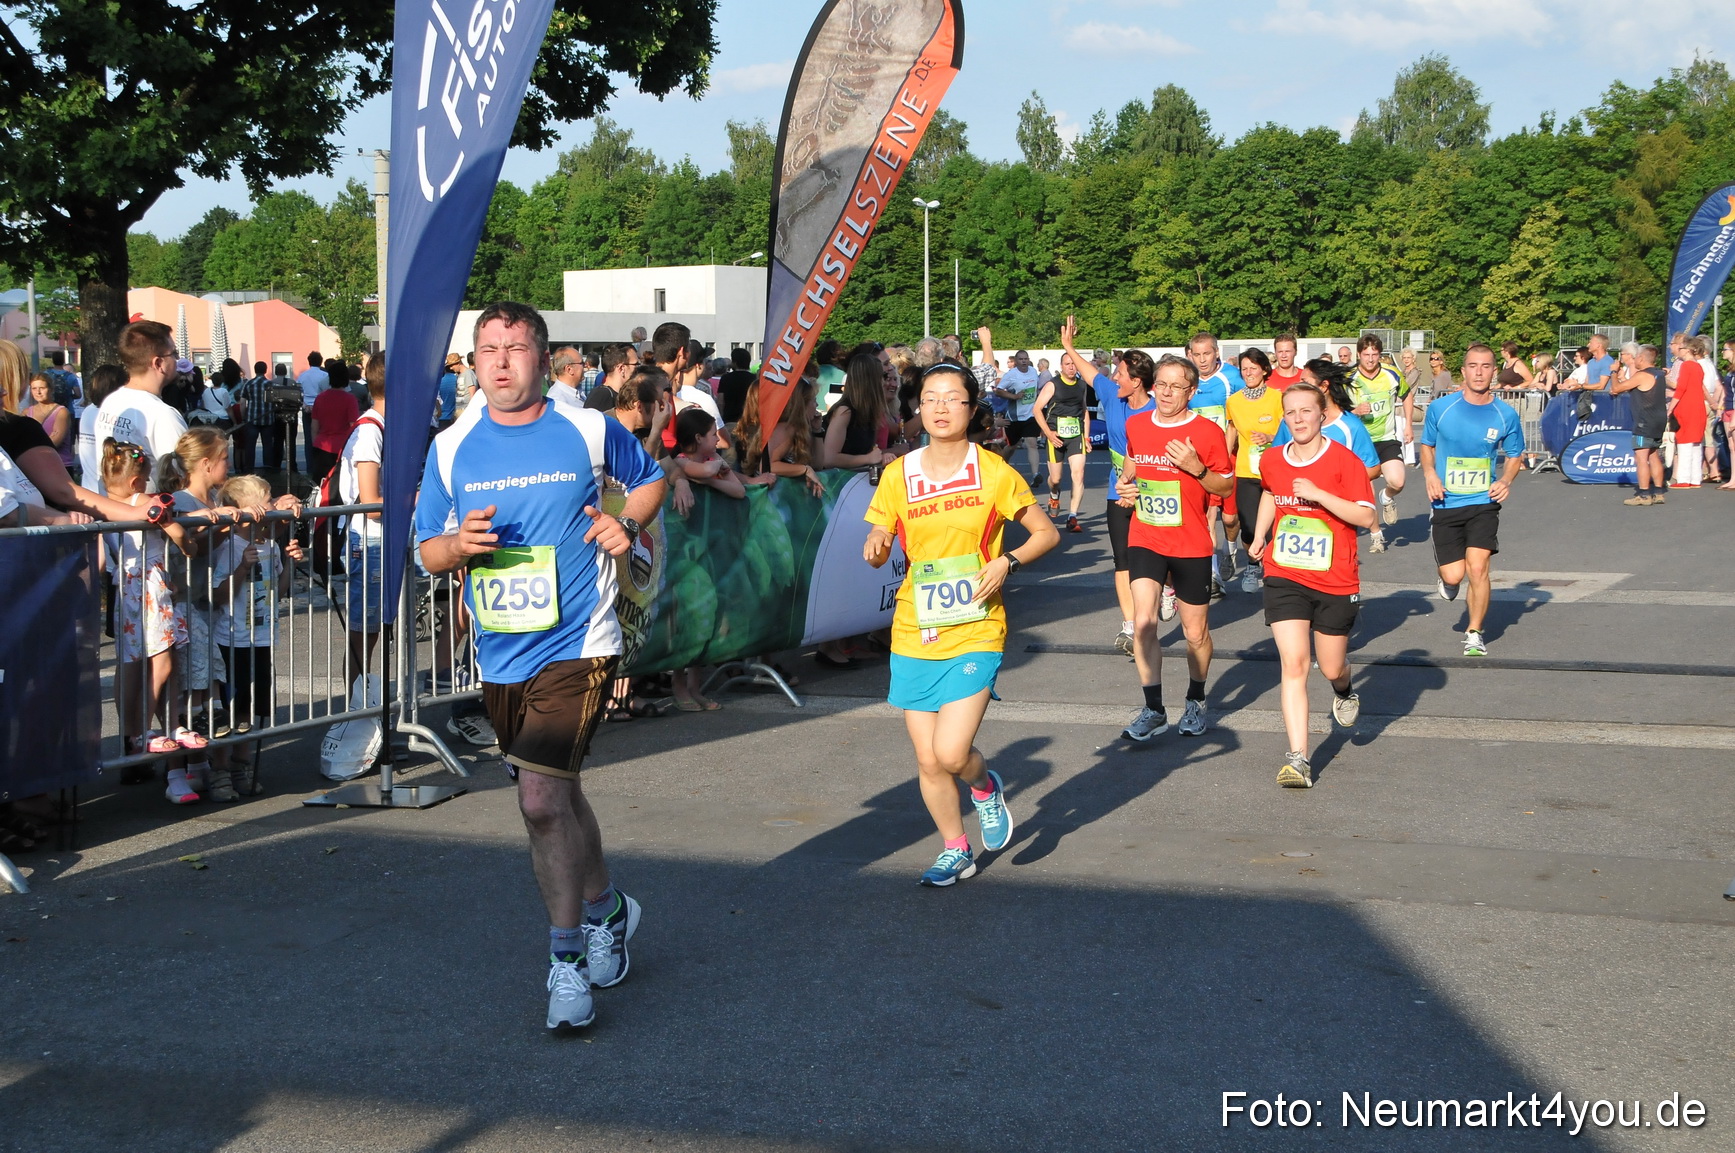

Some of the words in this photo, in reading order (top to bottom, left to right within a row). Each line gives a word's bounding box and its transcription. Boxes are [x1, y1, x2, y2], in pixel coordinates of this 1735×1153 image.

[477, 0, 521, 128] AUTO
[1672, 224, 1734, 314] Frischmann
[1060, 425, 1079, 435] 5062
[1587, 453, 1635, 468] Fisch
[464, 470, 577, 492] energiegeladen
[1448, 471, 1486, 485] 1171
[908, 503, 939, 520] MAX
[943, 495, 985, 511] BÖGL
[1137, 494, 1178, 515] 1339
[1277, 533, 1327, 557] 1341
[475, 576, 551, 611] 1259
[921, 579, 973, 611] 790
